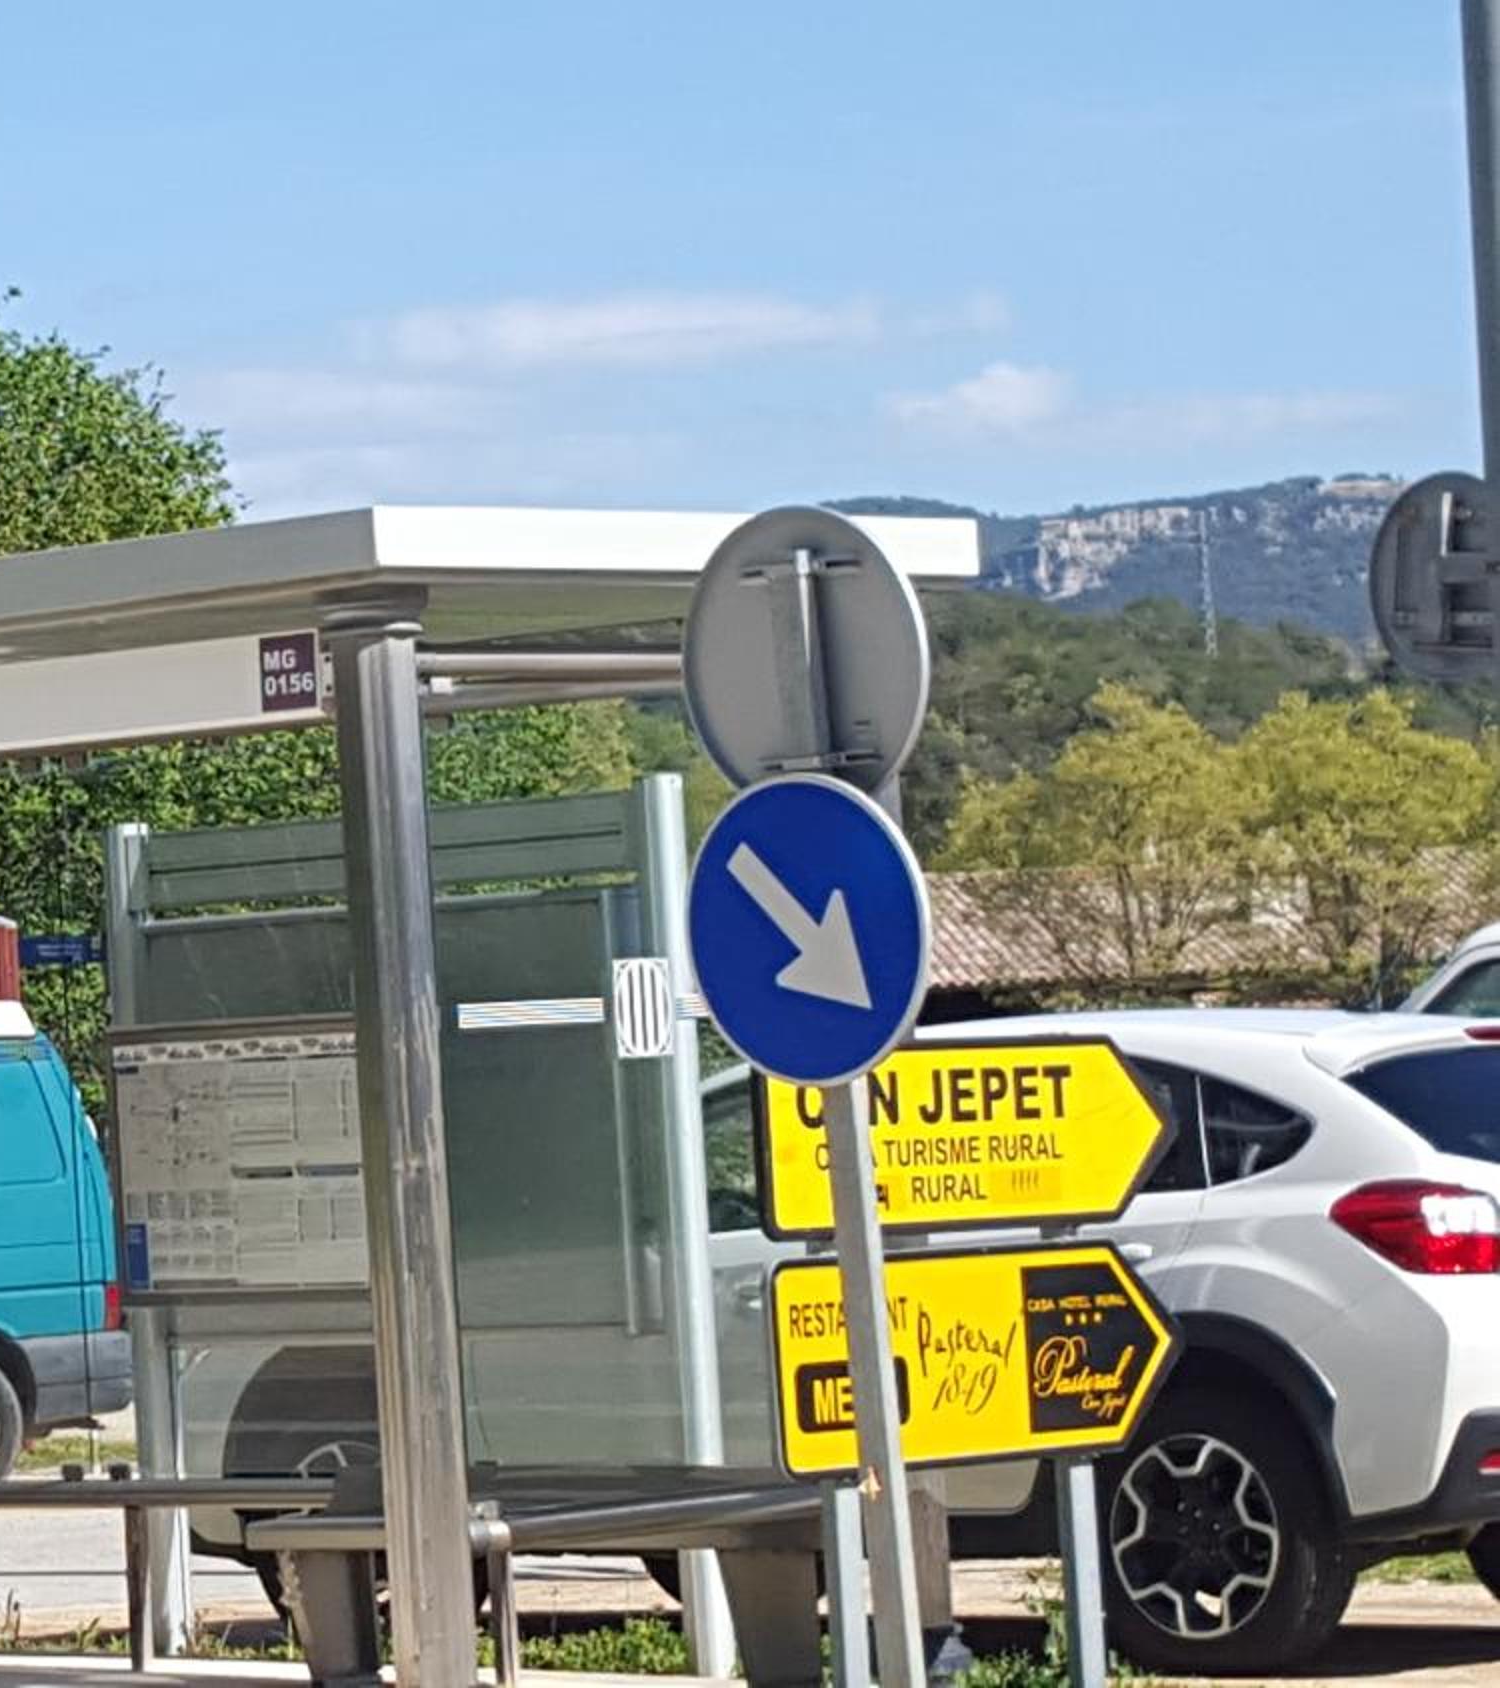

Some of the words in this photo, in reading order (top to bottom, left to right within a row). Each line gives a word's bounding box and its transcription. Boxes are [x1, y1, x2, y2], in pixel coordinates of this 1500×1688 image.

[263, 649, 297, 672] MG
[264, 672, 315, 696] 0156
[796, 1071, 899, 1129] CN
[919, 1065, 1071, 1124] JEPET
[883, 1136, 981, 1168] TURISME
[988, 1132, 1064, 1163] RURAL
[911, 1173, 988, 1204] RURAL
[812, 1375, 857, 1426] ME
